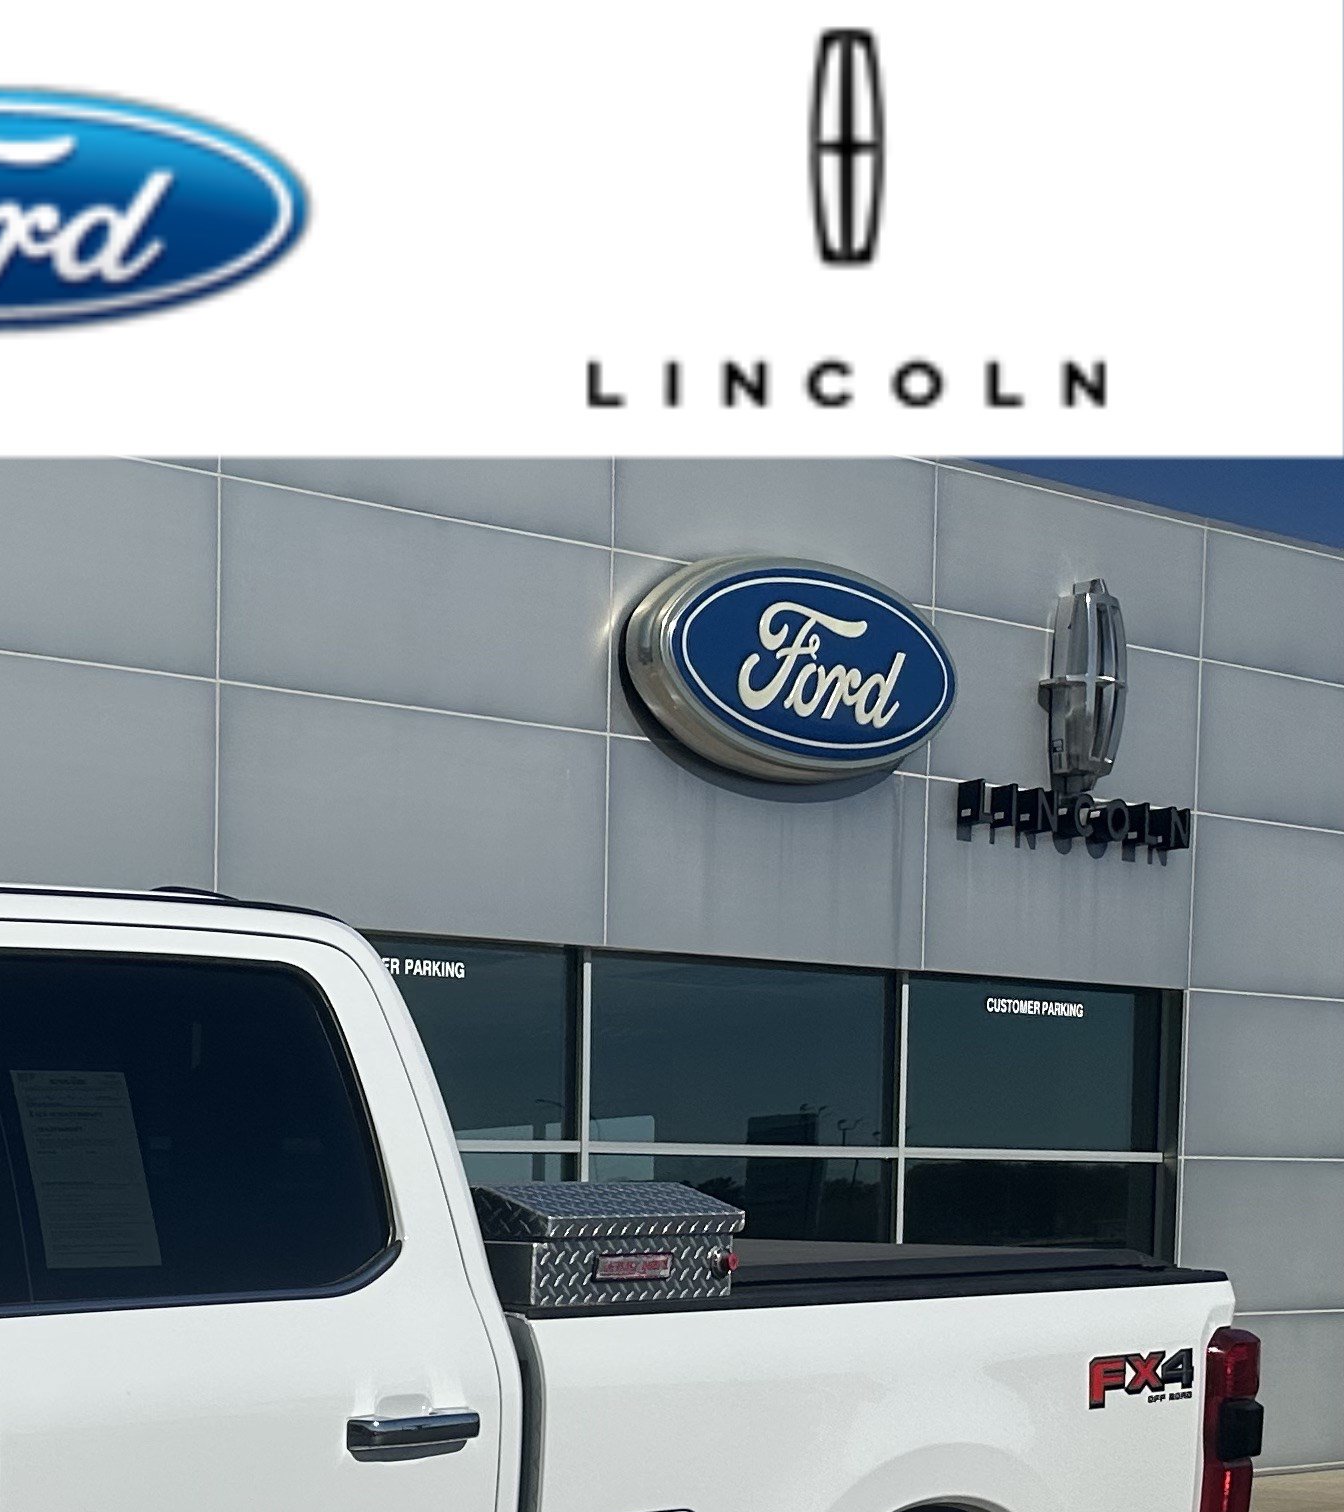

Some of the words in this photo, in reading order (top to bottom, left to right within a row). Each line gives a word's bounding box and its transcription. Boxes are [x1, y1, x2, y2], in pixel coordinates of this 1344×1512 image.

[738, 601, 906, 729] Ford
[958, 779, 1191, 850] LINCOLN
[404, 959, 465, 978] PARKING
[986, 997, 1041, 1015] CUSTOMER
[1041, 1001, 1084, 1018] PARKING
[1089, 1347, 1194, 1410] FX4
[1147, 1393, 1166, 1404] OFF
[1169, 1390, 1193, 1401] ROAD
